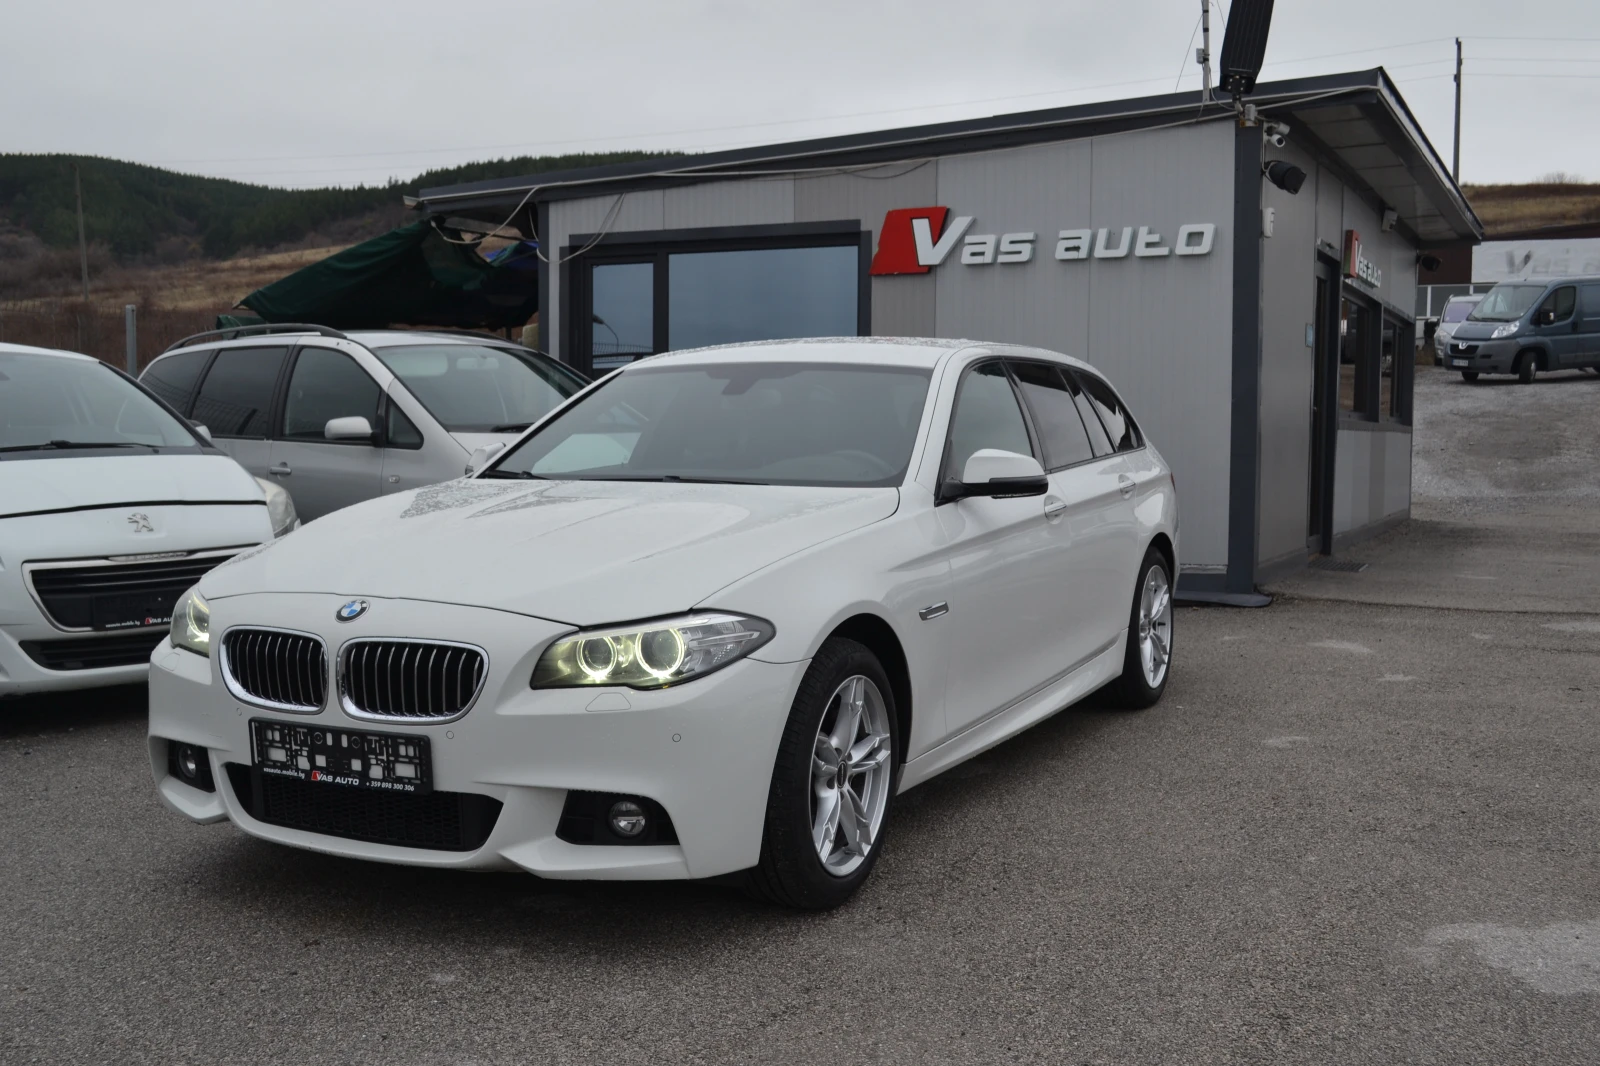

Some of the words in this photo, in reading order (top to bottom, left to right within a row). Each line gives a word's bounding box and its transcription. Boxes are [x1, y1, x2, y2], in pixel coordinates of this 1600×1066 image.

[911, 216, 1037, 266] Vas
[1054, 223, 1216, 261] auto
[263, 767, 305, 779] vasauto.mobile.bg
[316, 772, 333, 782] VAS
[334, 776, 360, 786] AUTO
[371, 780, 381, 788] 359
